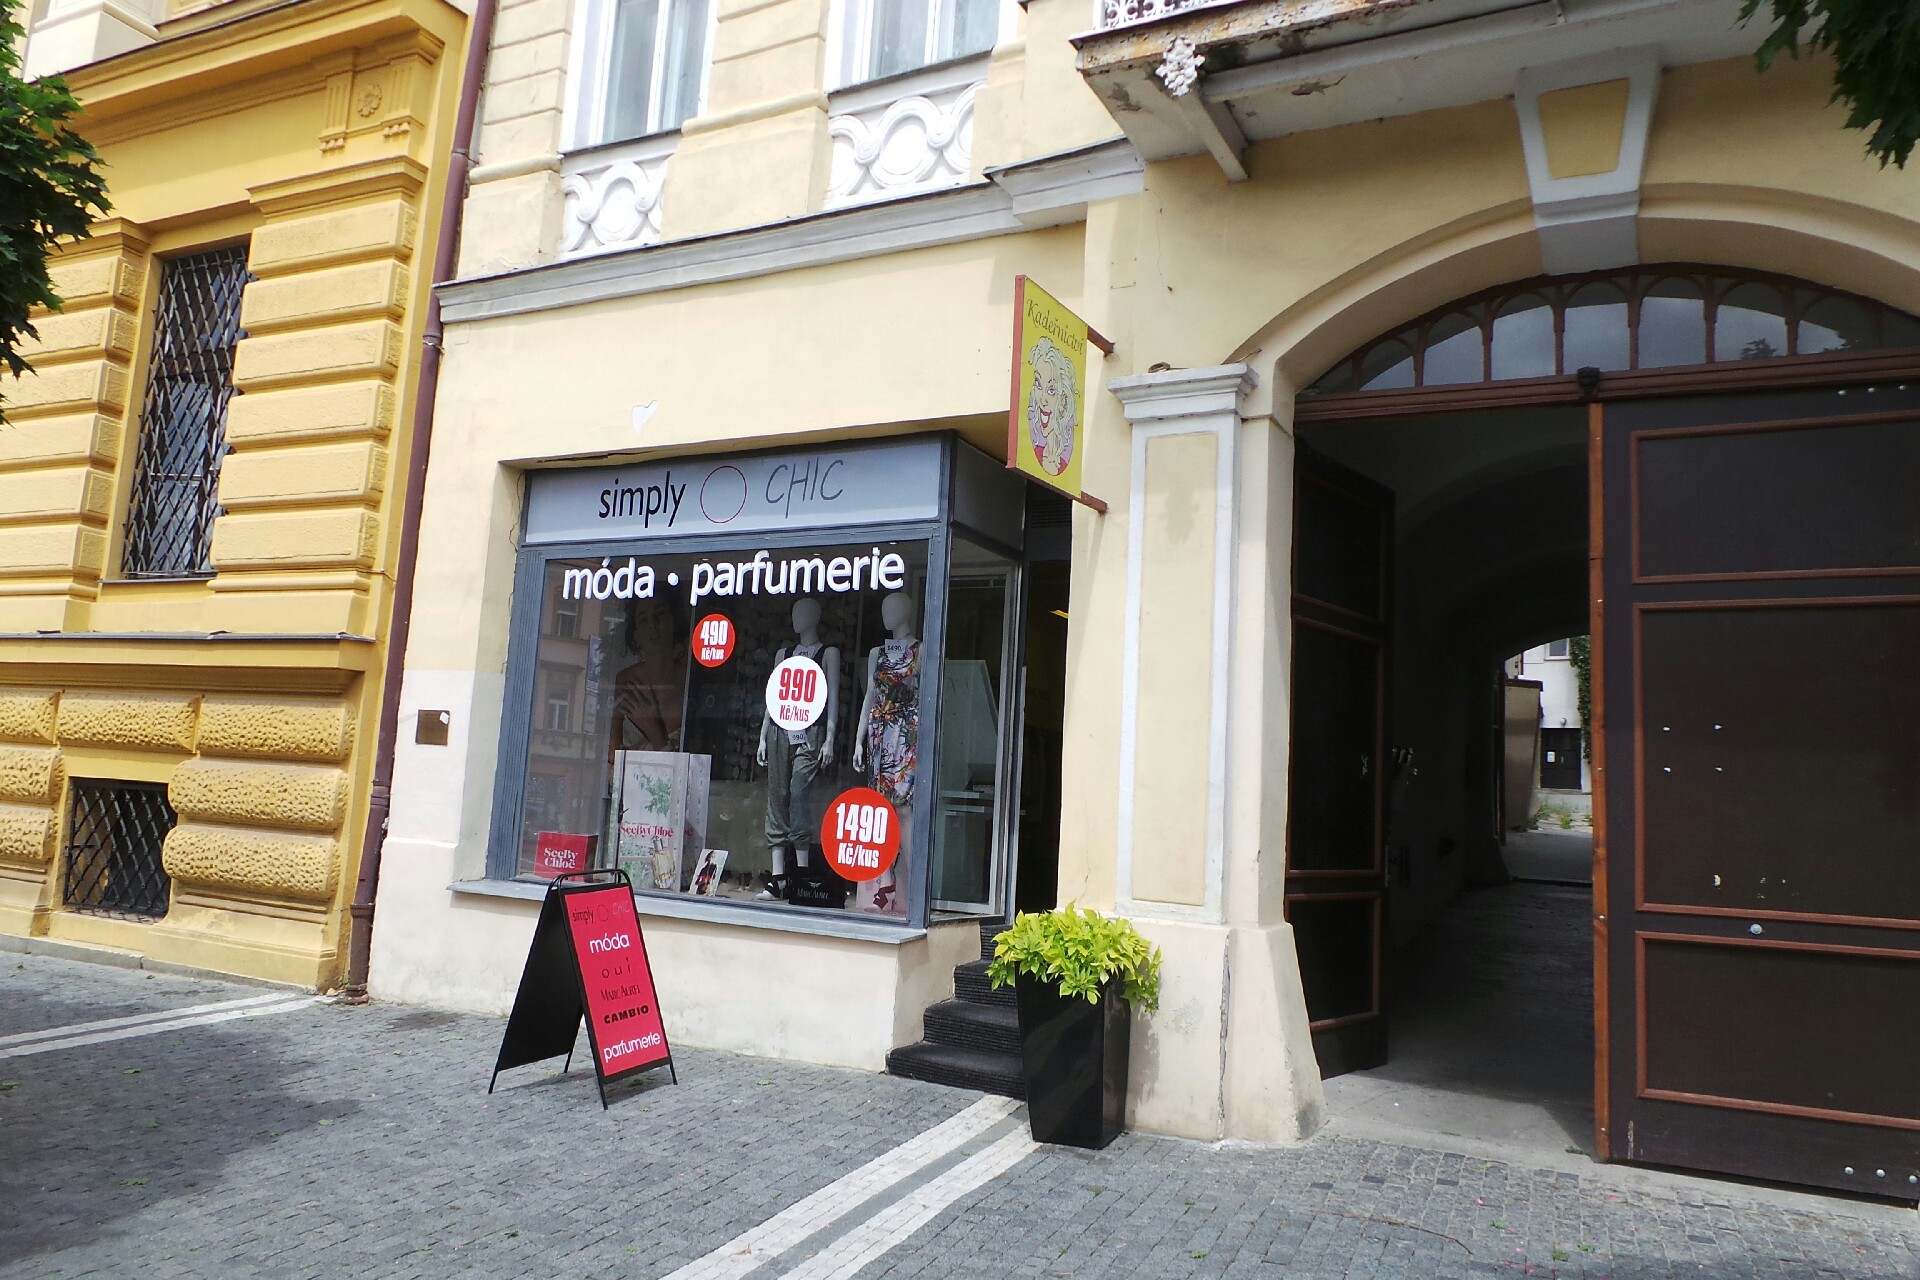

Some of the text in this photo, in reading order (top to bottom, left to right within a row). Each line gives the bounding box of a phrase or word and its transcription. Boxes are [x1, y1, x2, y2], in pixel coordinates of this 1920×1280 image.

[598, 457, 845, 529] simply CHIC
[562, 547, 906, 606] móda parfumerie
[700, 620, 728, 646] 490
[701, 647, 725, 662] Kč/kus
[778, 667, 817, 703] 990
[779, 704, 810, 723] Kč/kus
[836, 802, 888, 845] 1490
[837, 842, 880, 869] Kč/kus
[572, 905, 594, 925] simply
[589, 933, 630, 954] móda
[603, 1005, 649, 1025] CAMBIO
[603, 1032, 661, 1063] parfumerie
